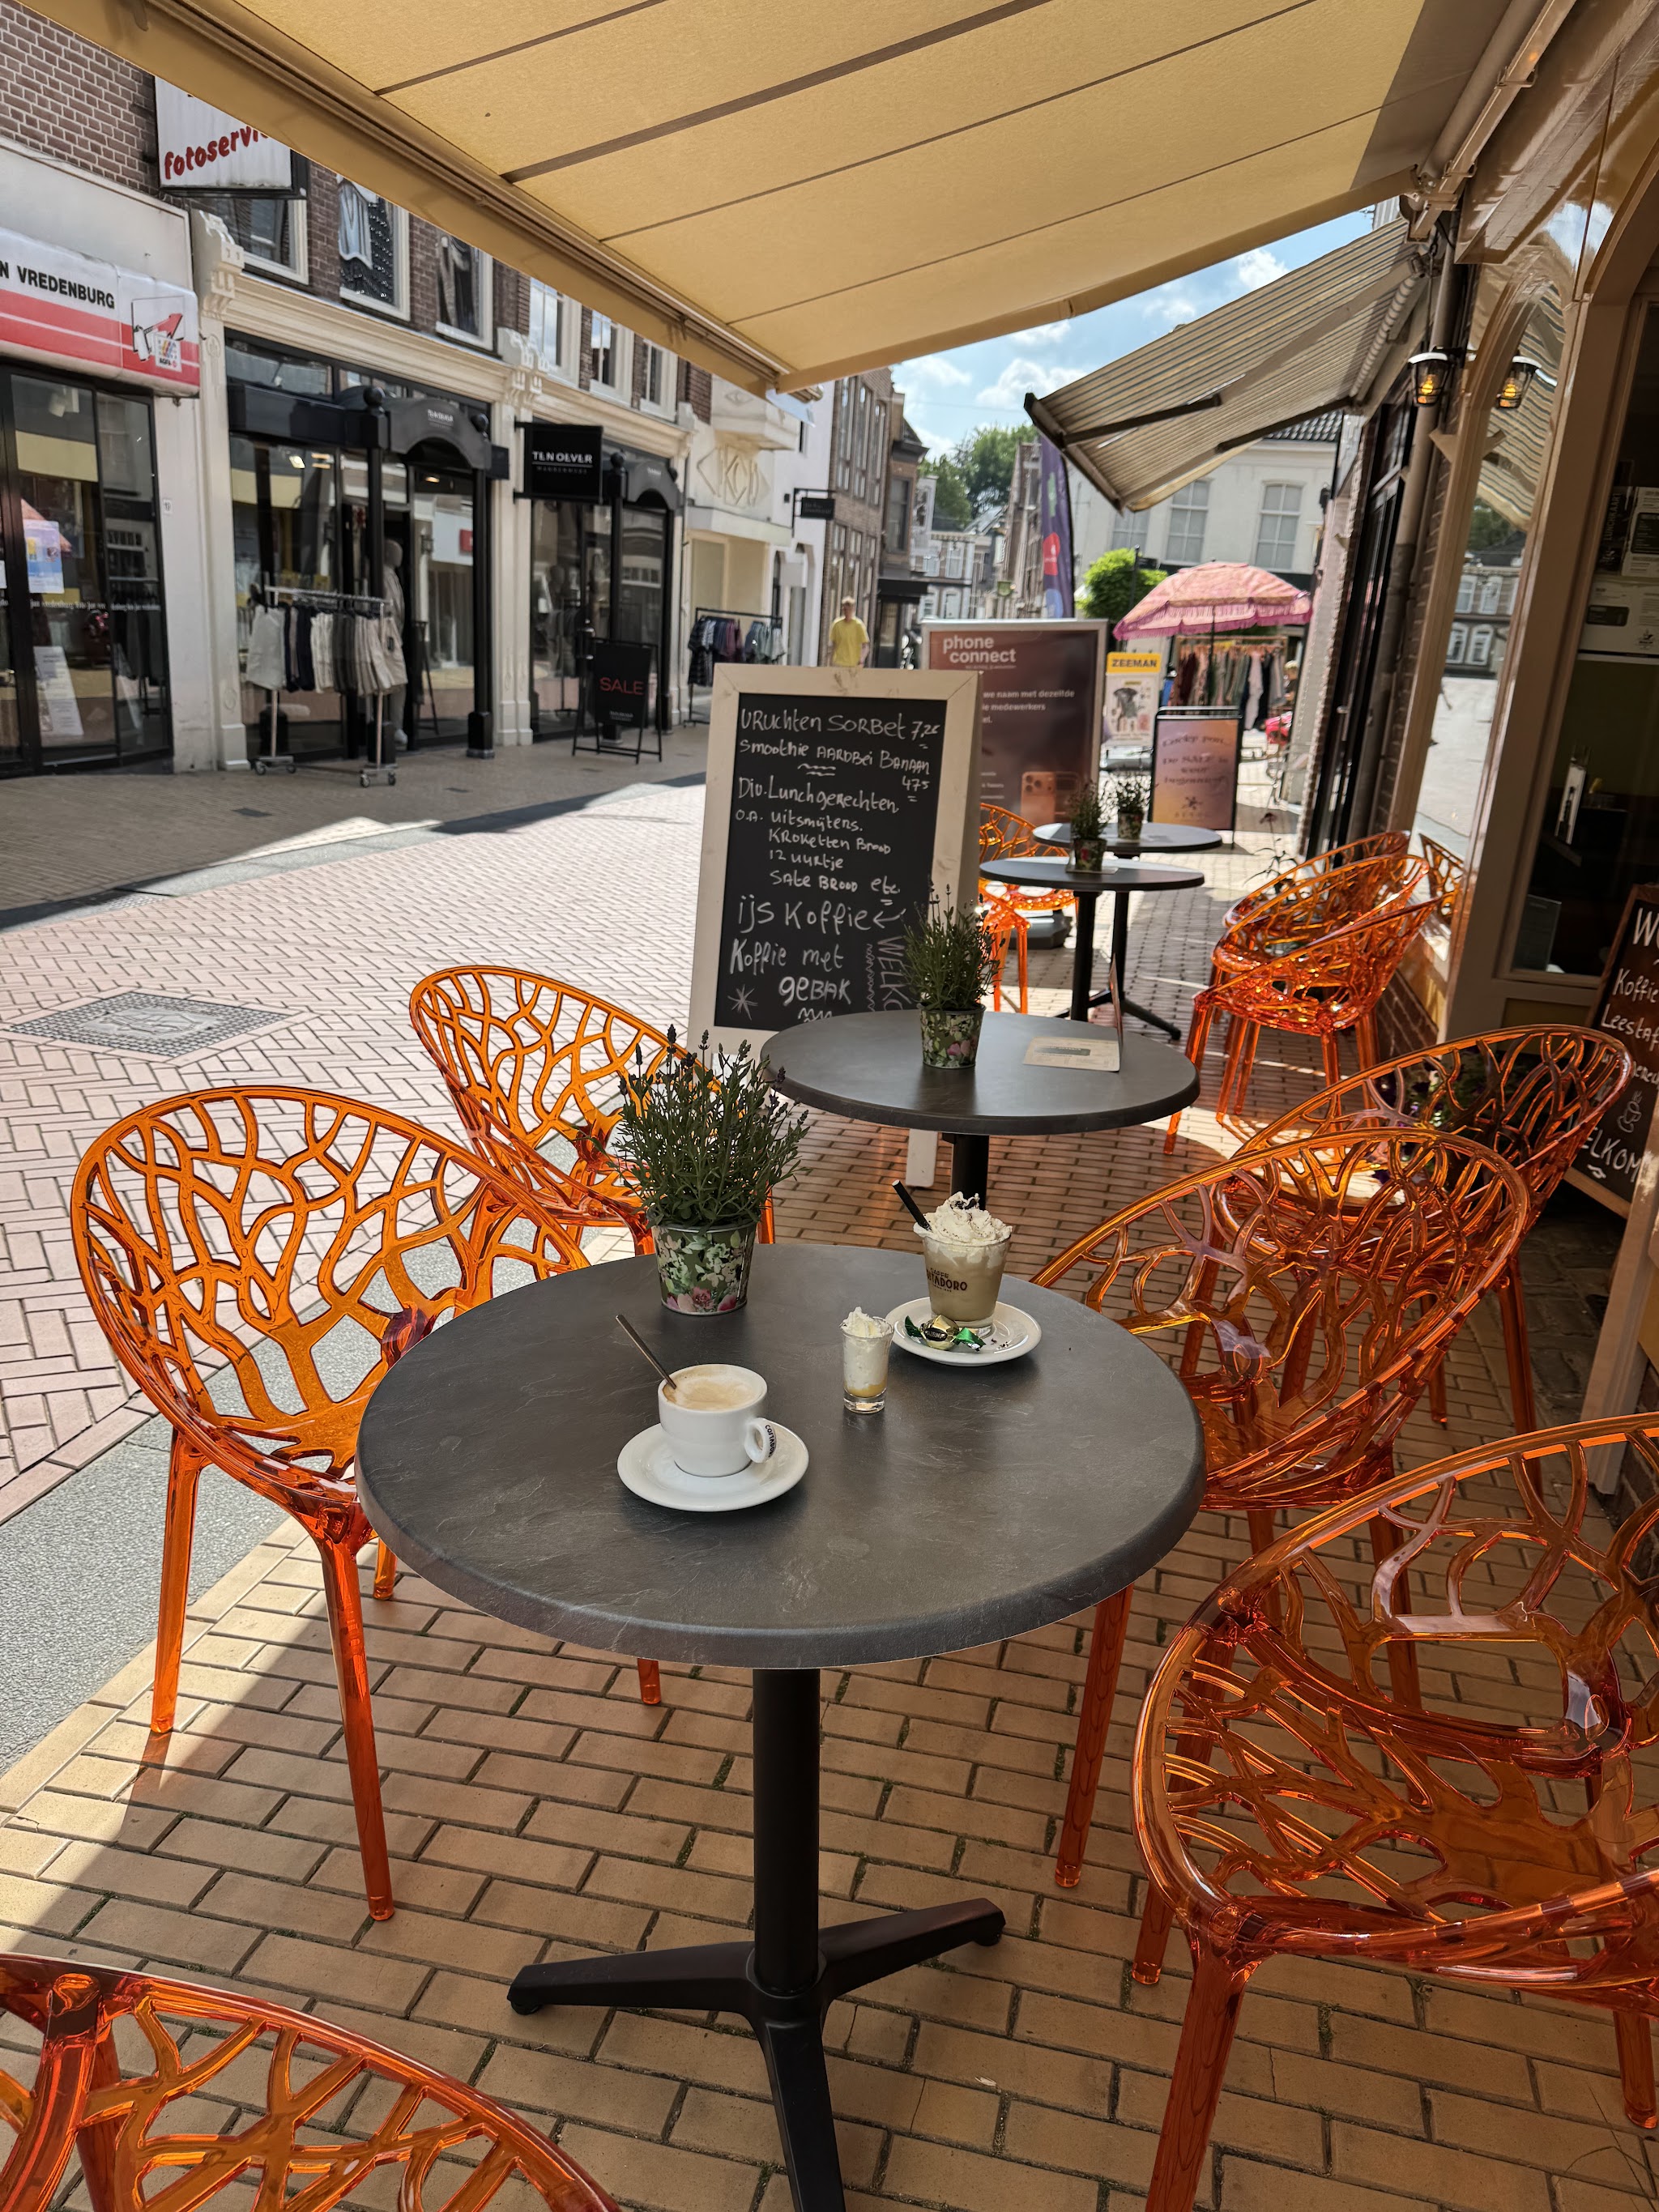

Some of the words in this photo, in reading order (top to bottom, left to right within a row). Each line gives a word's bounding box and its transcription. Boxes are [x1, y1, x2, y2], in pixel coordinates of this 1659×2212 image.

[17, 265, 115, 309] VREDENBURG
[532, 450, 554, 462] TEN
[943, 635, 995, 654] phone
[949, 649, 1017, 663] connect
[1112, 659, 1157, 667] ZEEMAN
[599, 677, 644, 695] SALE
[991, 702, 1046, 711] medewerkers
[770, 849, 787, 860] 12
[730, 938, 787, 976] Koffie
[802, 944, 844, 973] met
[1612, 967, 1659, 1004] Koffie
